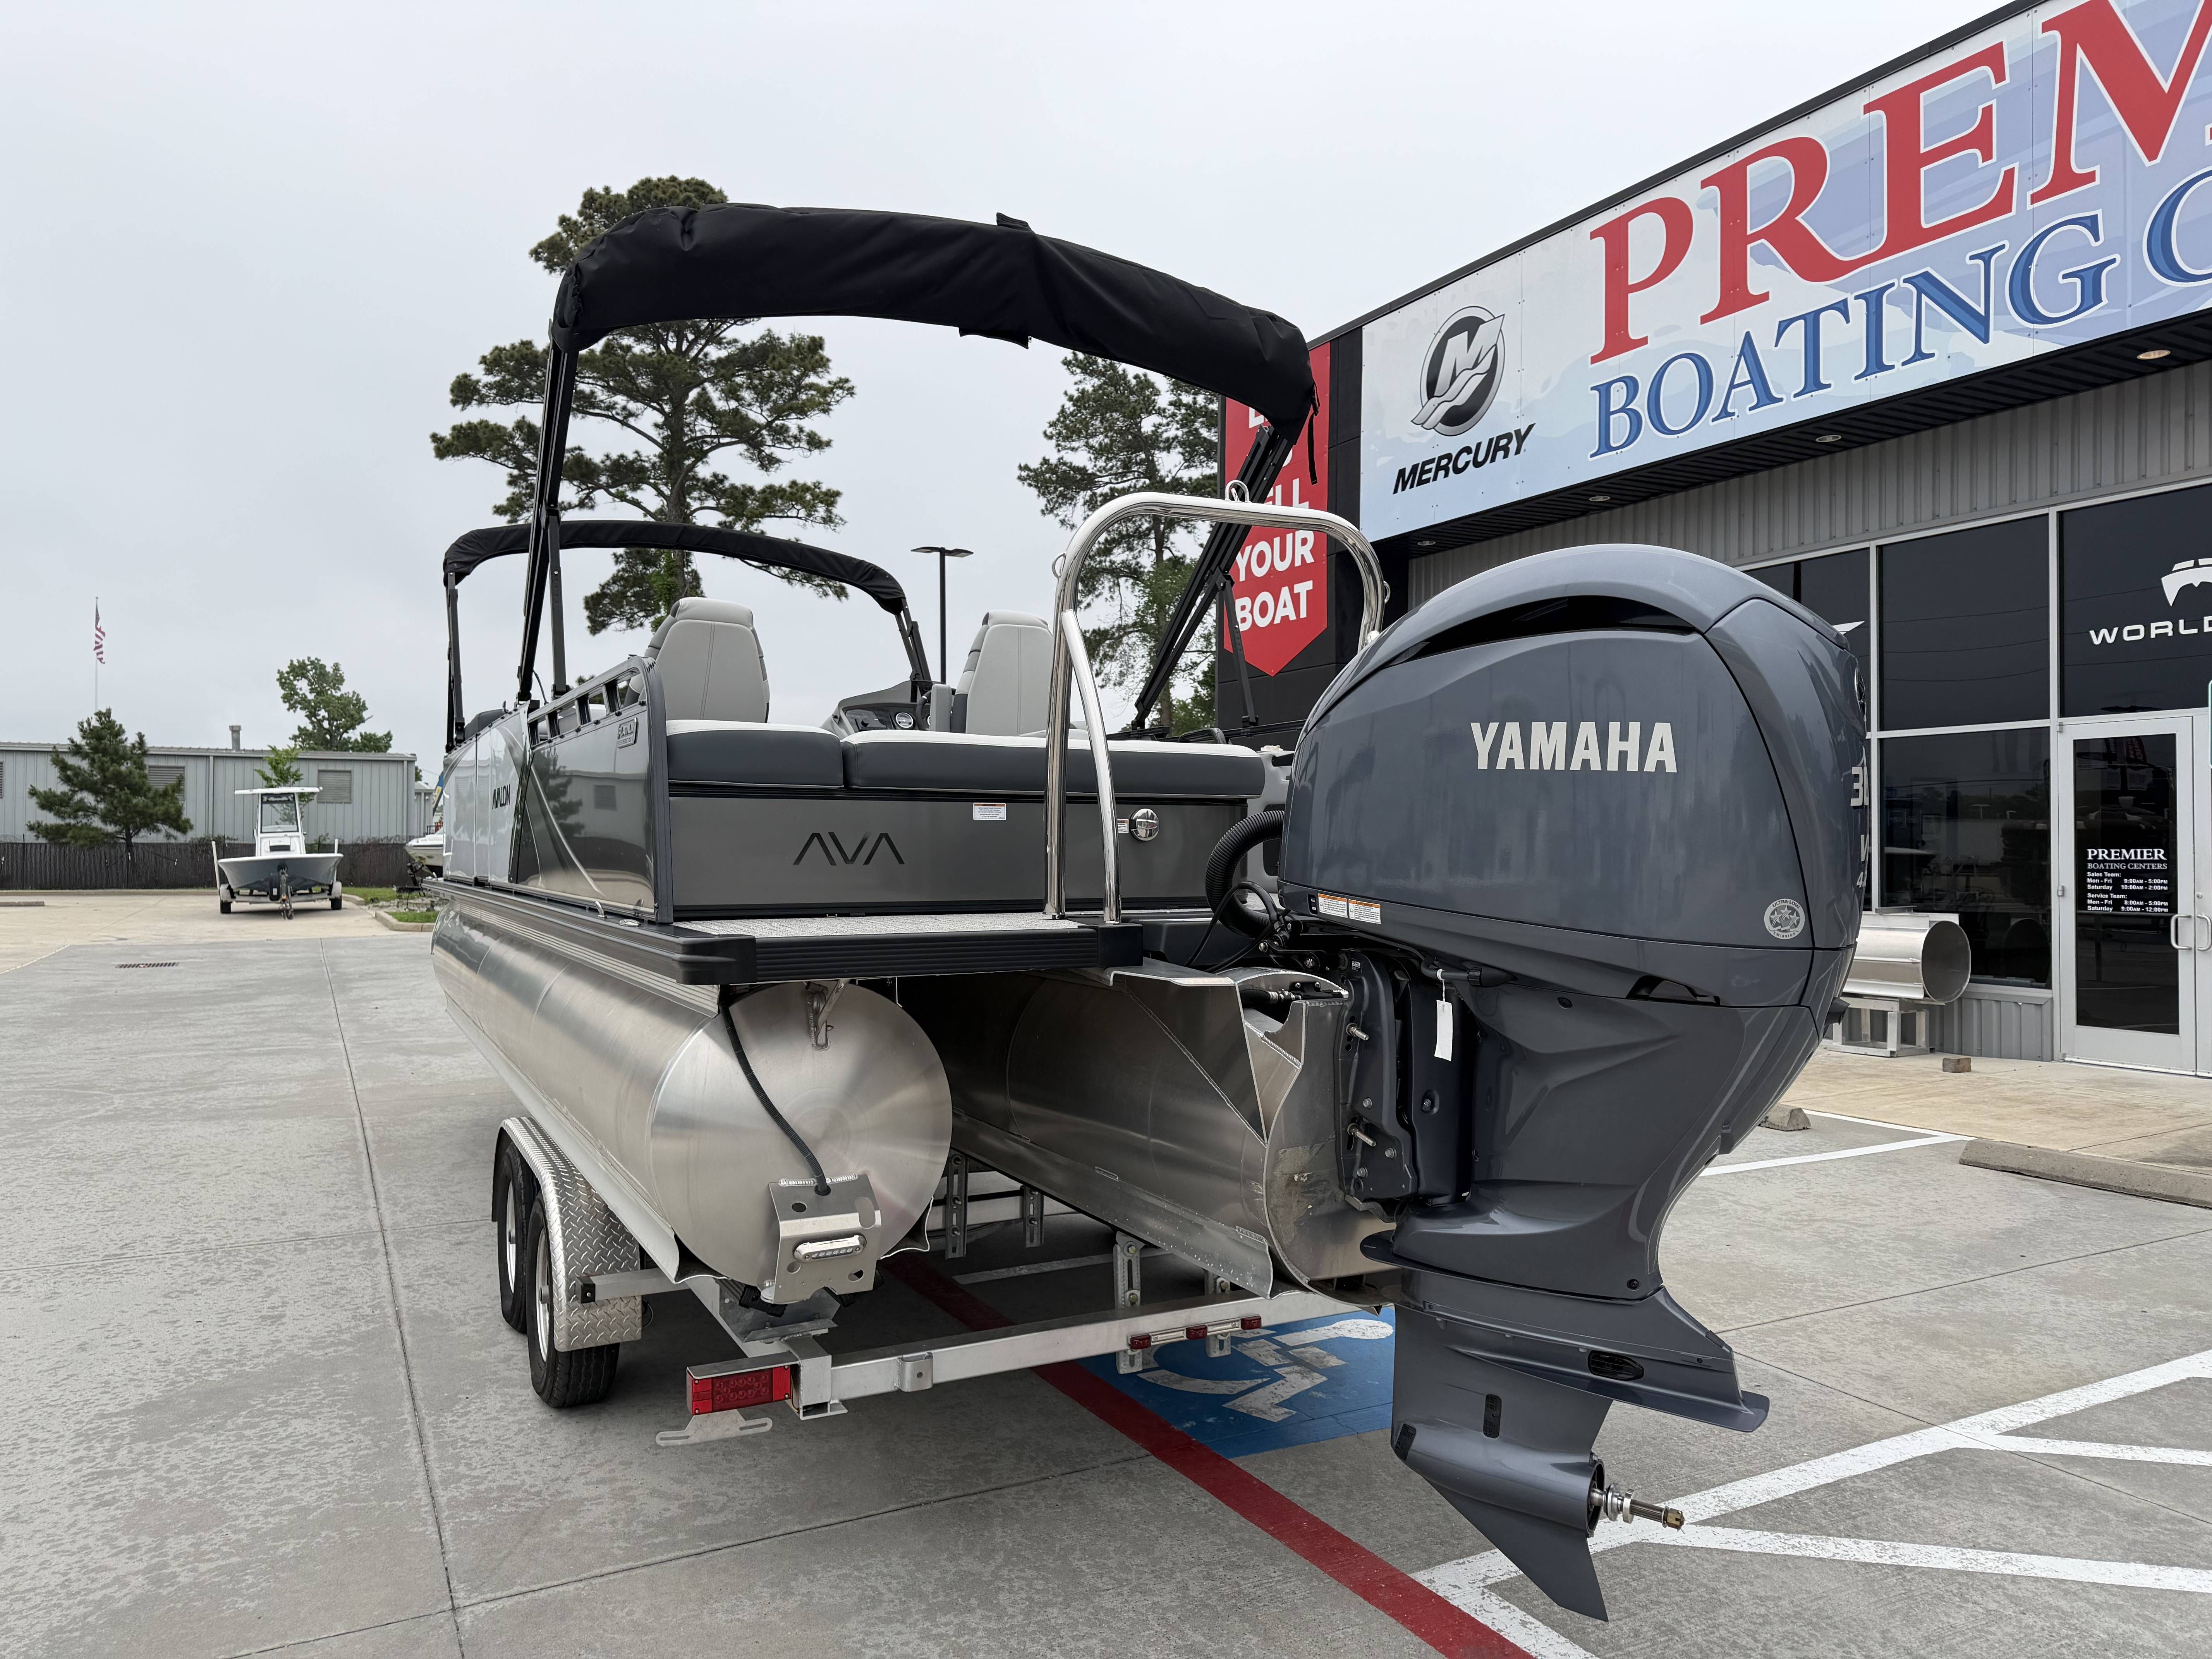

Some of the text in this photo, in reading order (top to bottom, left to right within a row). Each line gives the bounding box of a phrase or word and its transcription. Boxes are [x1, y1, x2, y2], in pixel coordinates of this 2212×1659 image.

[1590, 215, 2117, 458] BOATING
[1393, 423, 1536, 495] MERCURY
[1235, 530, 1314, 582] YOUR
[1235, 580, 1313, 632] BOAT
[1471, 722, 1677, 773] YAMAHA
[2087, 848, 2167, 860] PREMIER
